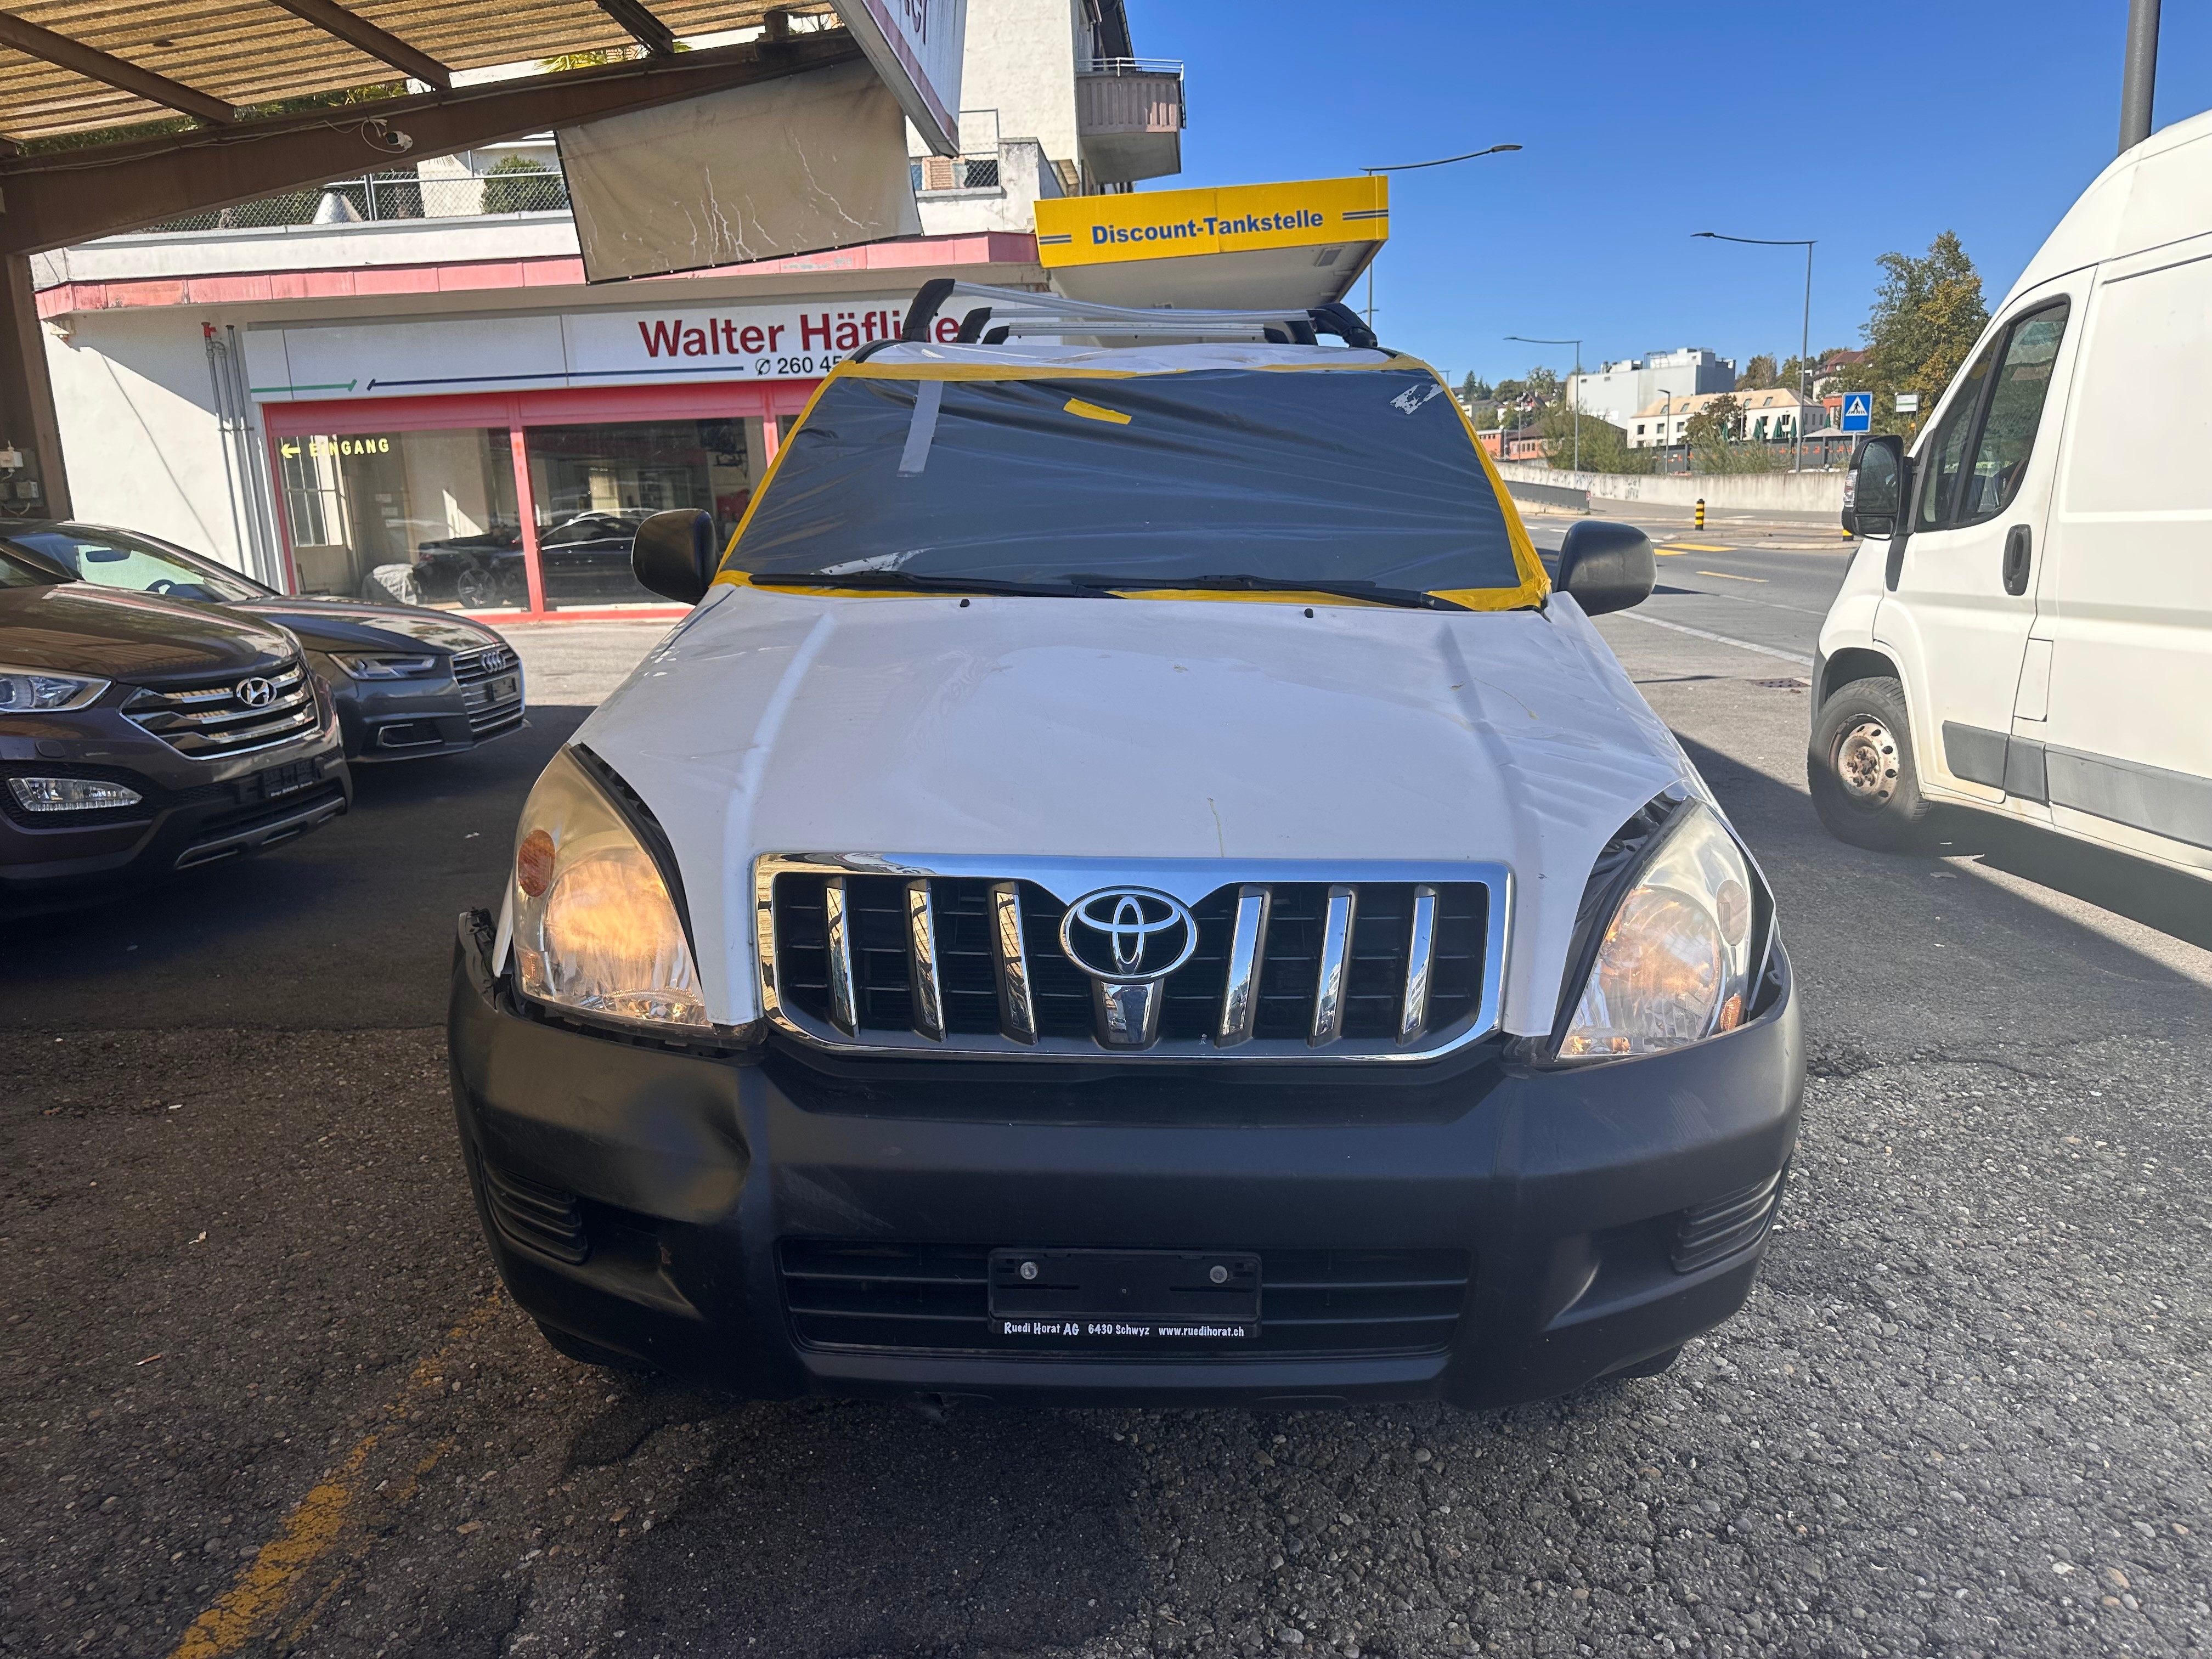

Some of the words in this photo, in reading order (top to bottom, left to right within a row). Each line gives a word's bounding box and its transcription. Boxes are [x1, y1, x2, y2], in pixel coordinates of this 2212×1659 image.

[1092, 210, 1323, 245] Discount-Tankstelle
[639, 318, 785, 358] Walter
[777, 357, 813, 374] 260
[309, 438, 390, 458] EINGANG
[1004, 1322, 1031, 1334] Ruedi
[1034, 1322, 1060, 1335] Horat
[1063, 1323, 1080, 1335] AG
[1088, 1324, 1113, 1335] 6430
[1115, 1324, 1150, 1337] Schwyz
[1158, 1325, 1244, 1337] www.ruedihorat.ch
